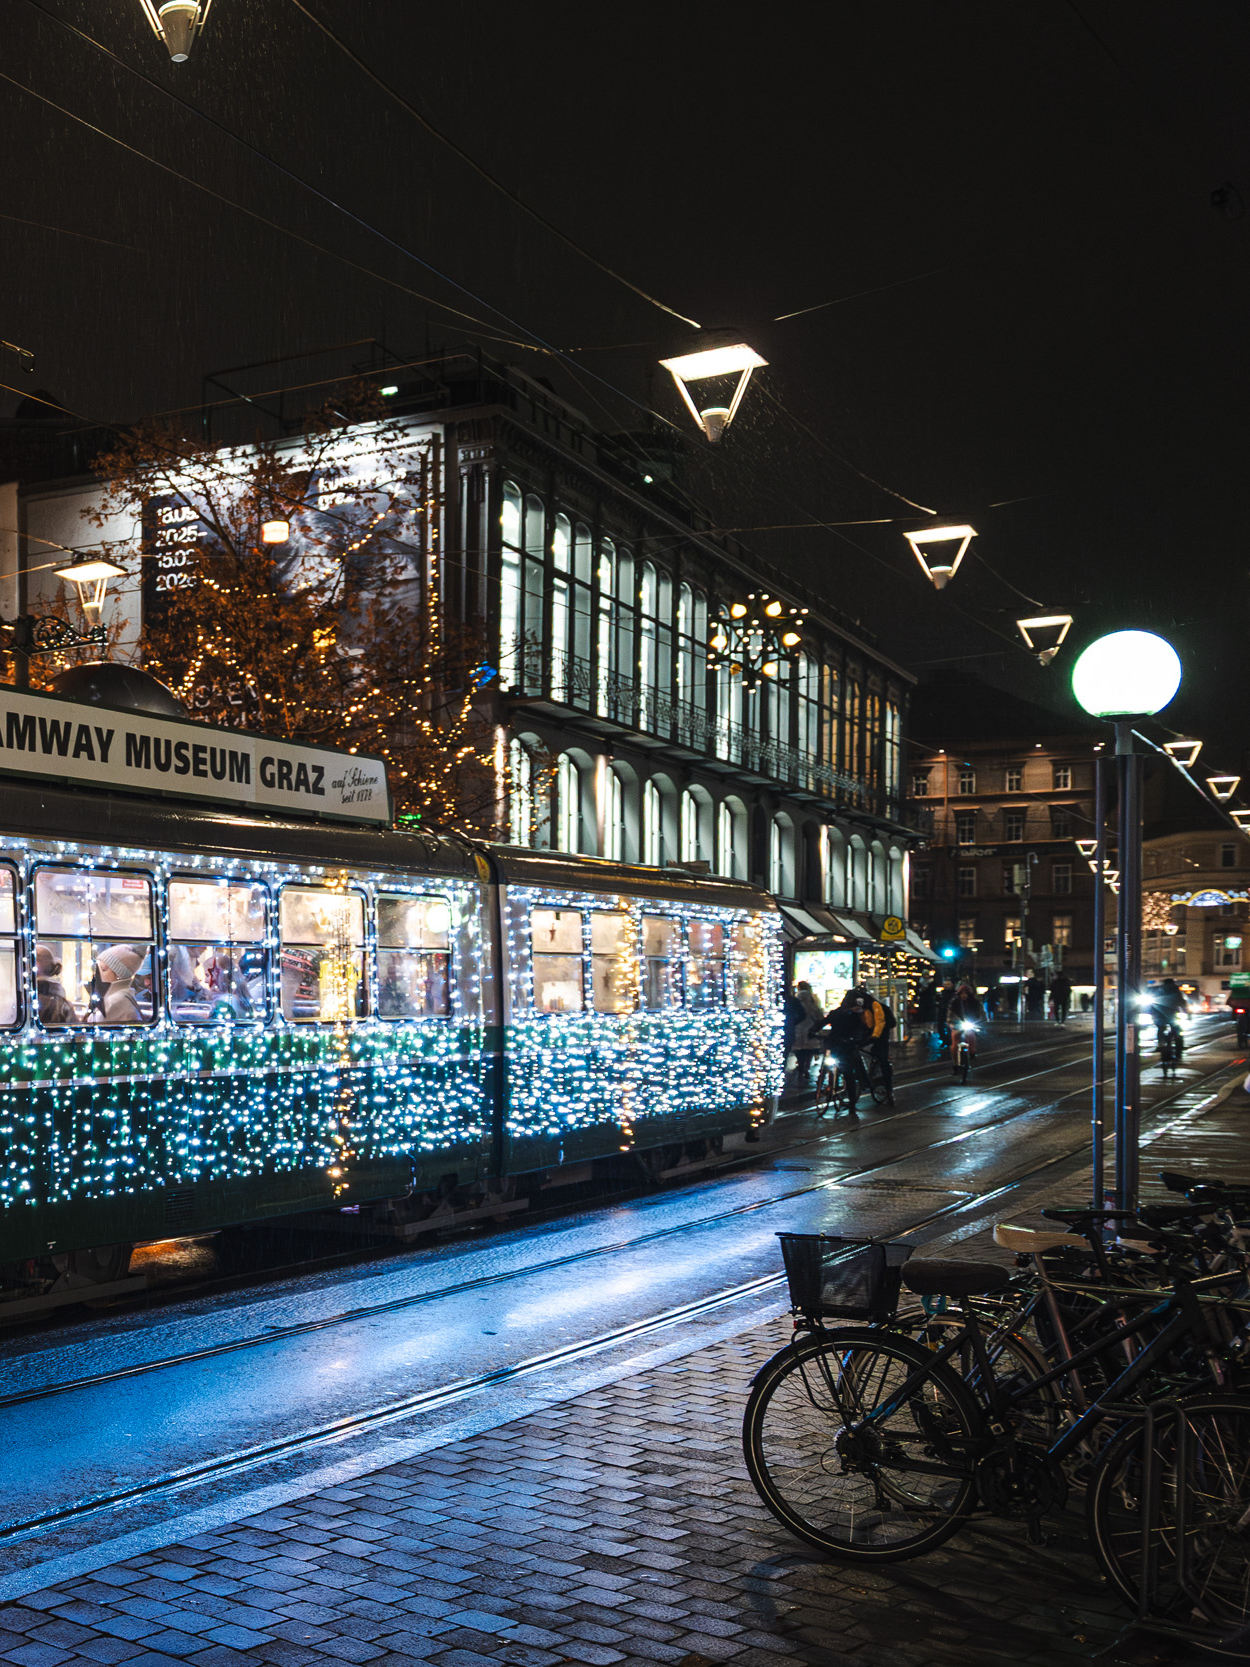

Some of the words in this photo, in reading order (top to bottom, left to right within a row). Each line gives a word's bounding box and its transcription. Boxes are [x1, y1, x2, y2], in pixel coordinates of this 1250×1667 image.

[318, 467, 407, 493] kunsthas
[124, 732, 252, 784] MUSEUM
[259, 756, 326, 796] GRAZ
